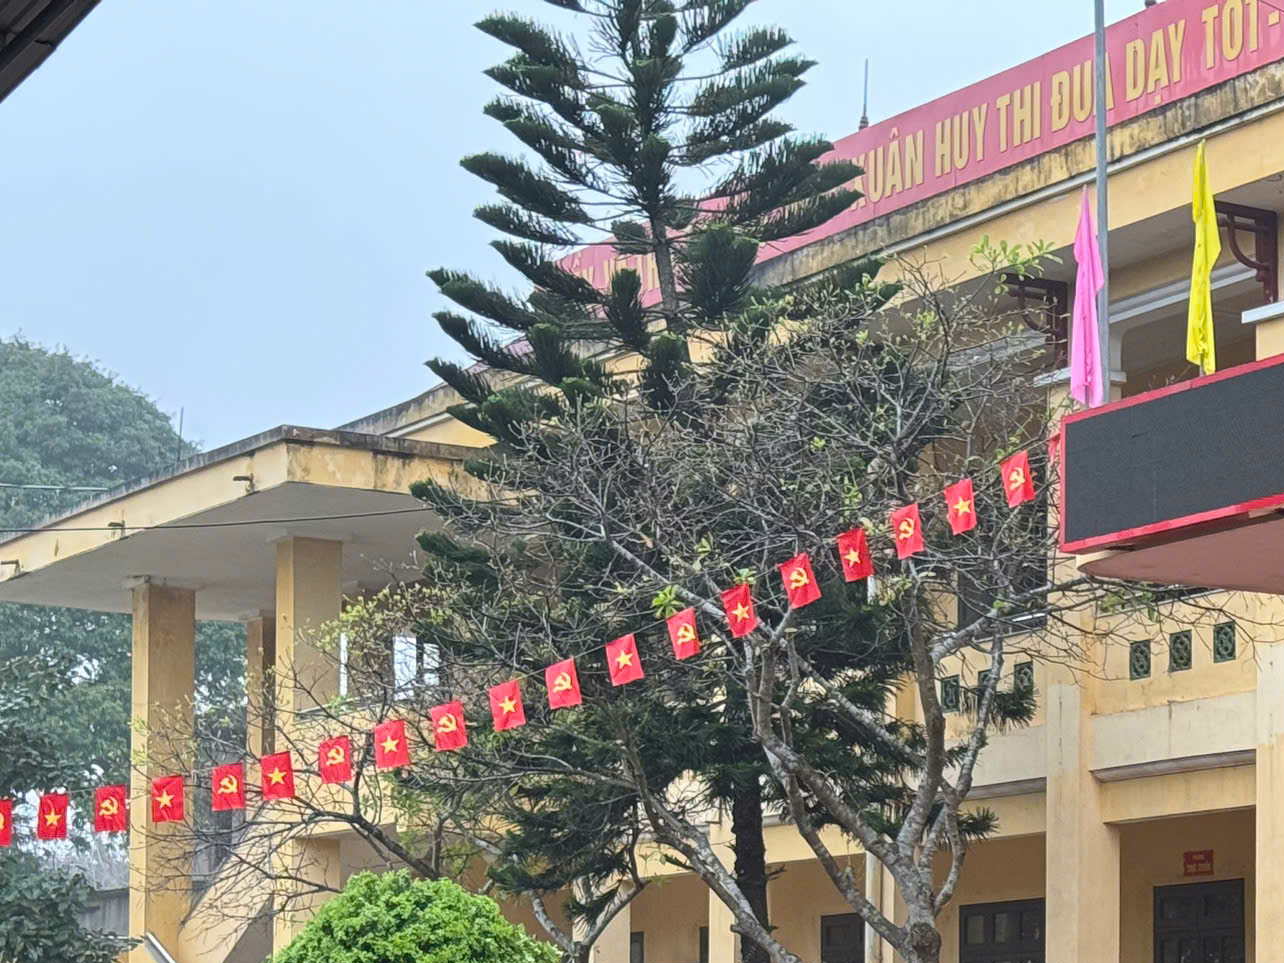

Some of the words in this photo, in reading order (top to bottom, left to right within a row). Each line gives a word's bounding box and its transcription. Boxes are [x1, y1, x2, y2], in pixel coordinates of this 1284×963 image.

[935, 103, 988, 177] HUY
[996, 81, 1041, 153] THI
[1126, 19, 1186, 104] DẠY
